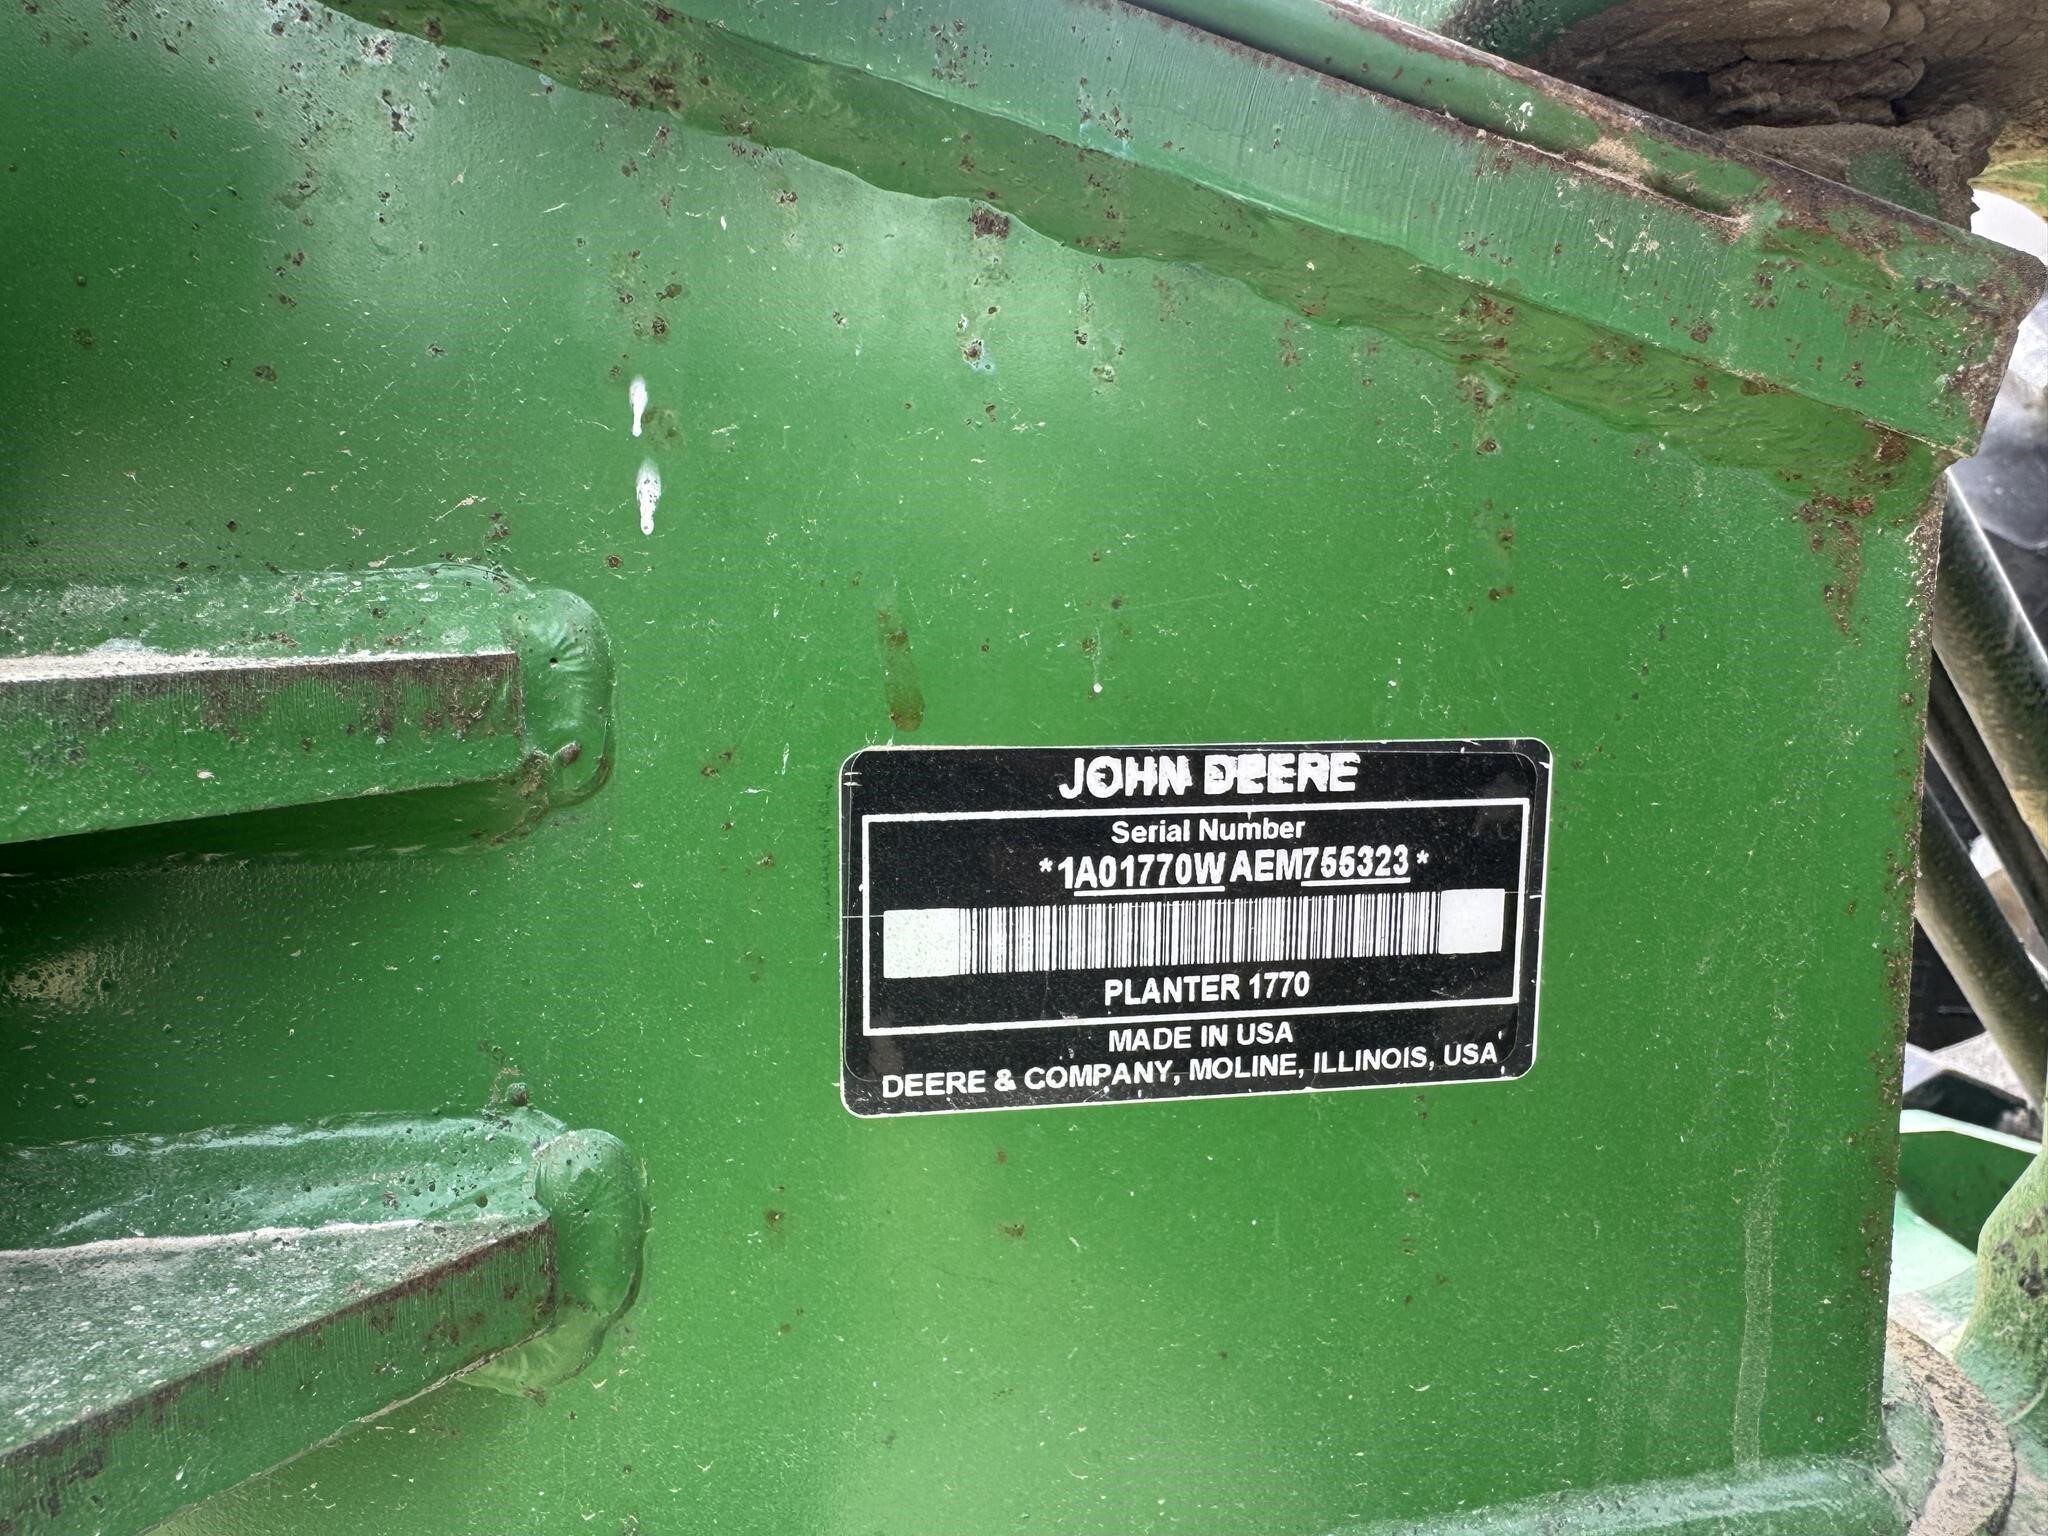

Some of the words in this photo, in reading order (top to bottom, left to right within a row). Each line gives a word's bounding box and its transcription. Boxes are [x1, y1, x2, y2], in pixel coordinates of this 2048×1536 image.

[1059, 754, 1193, 799] JOHN
[1203, 752, 1361, 795] DEERE
[1111, 819, 1191, 843] Serial
[1199, 818, 1306, 842] Number
[1105, 973, 1240, 1006] PLANTER
[1248, 971, 1311, 1000] 1770
[1109, 1025, 1192, 1052] MADE
[1201, 1024, 1229, 1048] IN
[1237, 1021, 1294, 1045] USA
[882, 1070, 987, 1098] DEERE
[994, 1069, 1017, 1092] &
[1024, 1060, 1181, 1090] COMPANY,
[1189, 1053, 1305, 1081] MOLINE,
[1313, 1046, 1435, 1074] ILLINOIS,
[1443, 1042, 1498, 1067] USA
